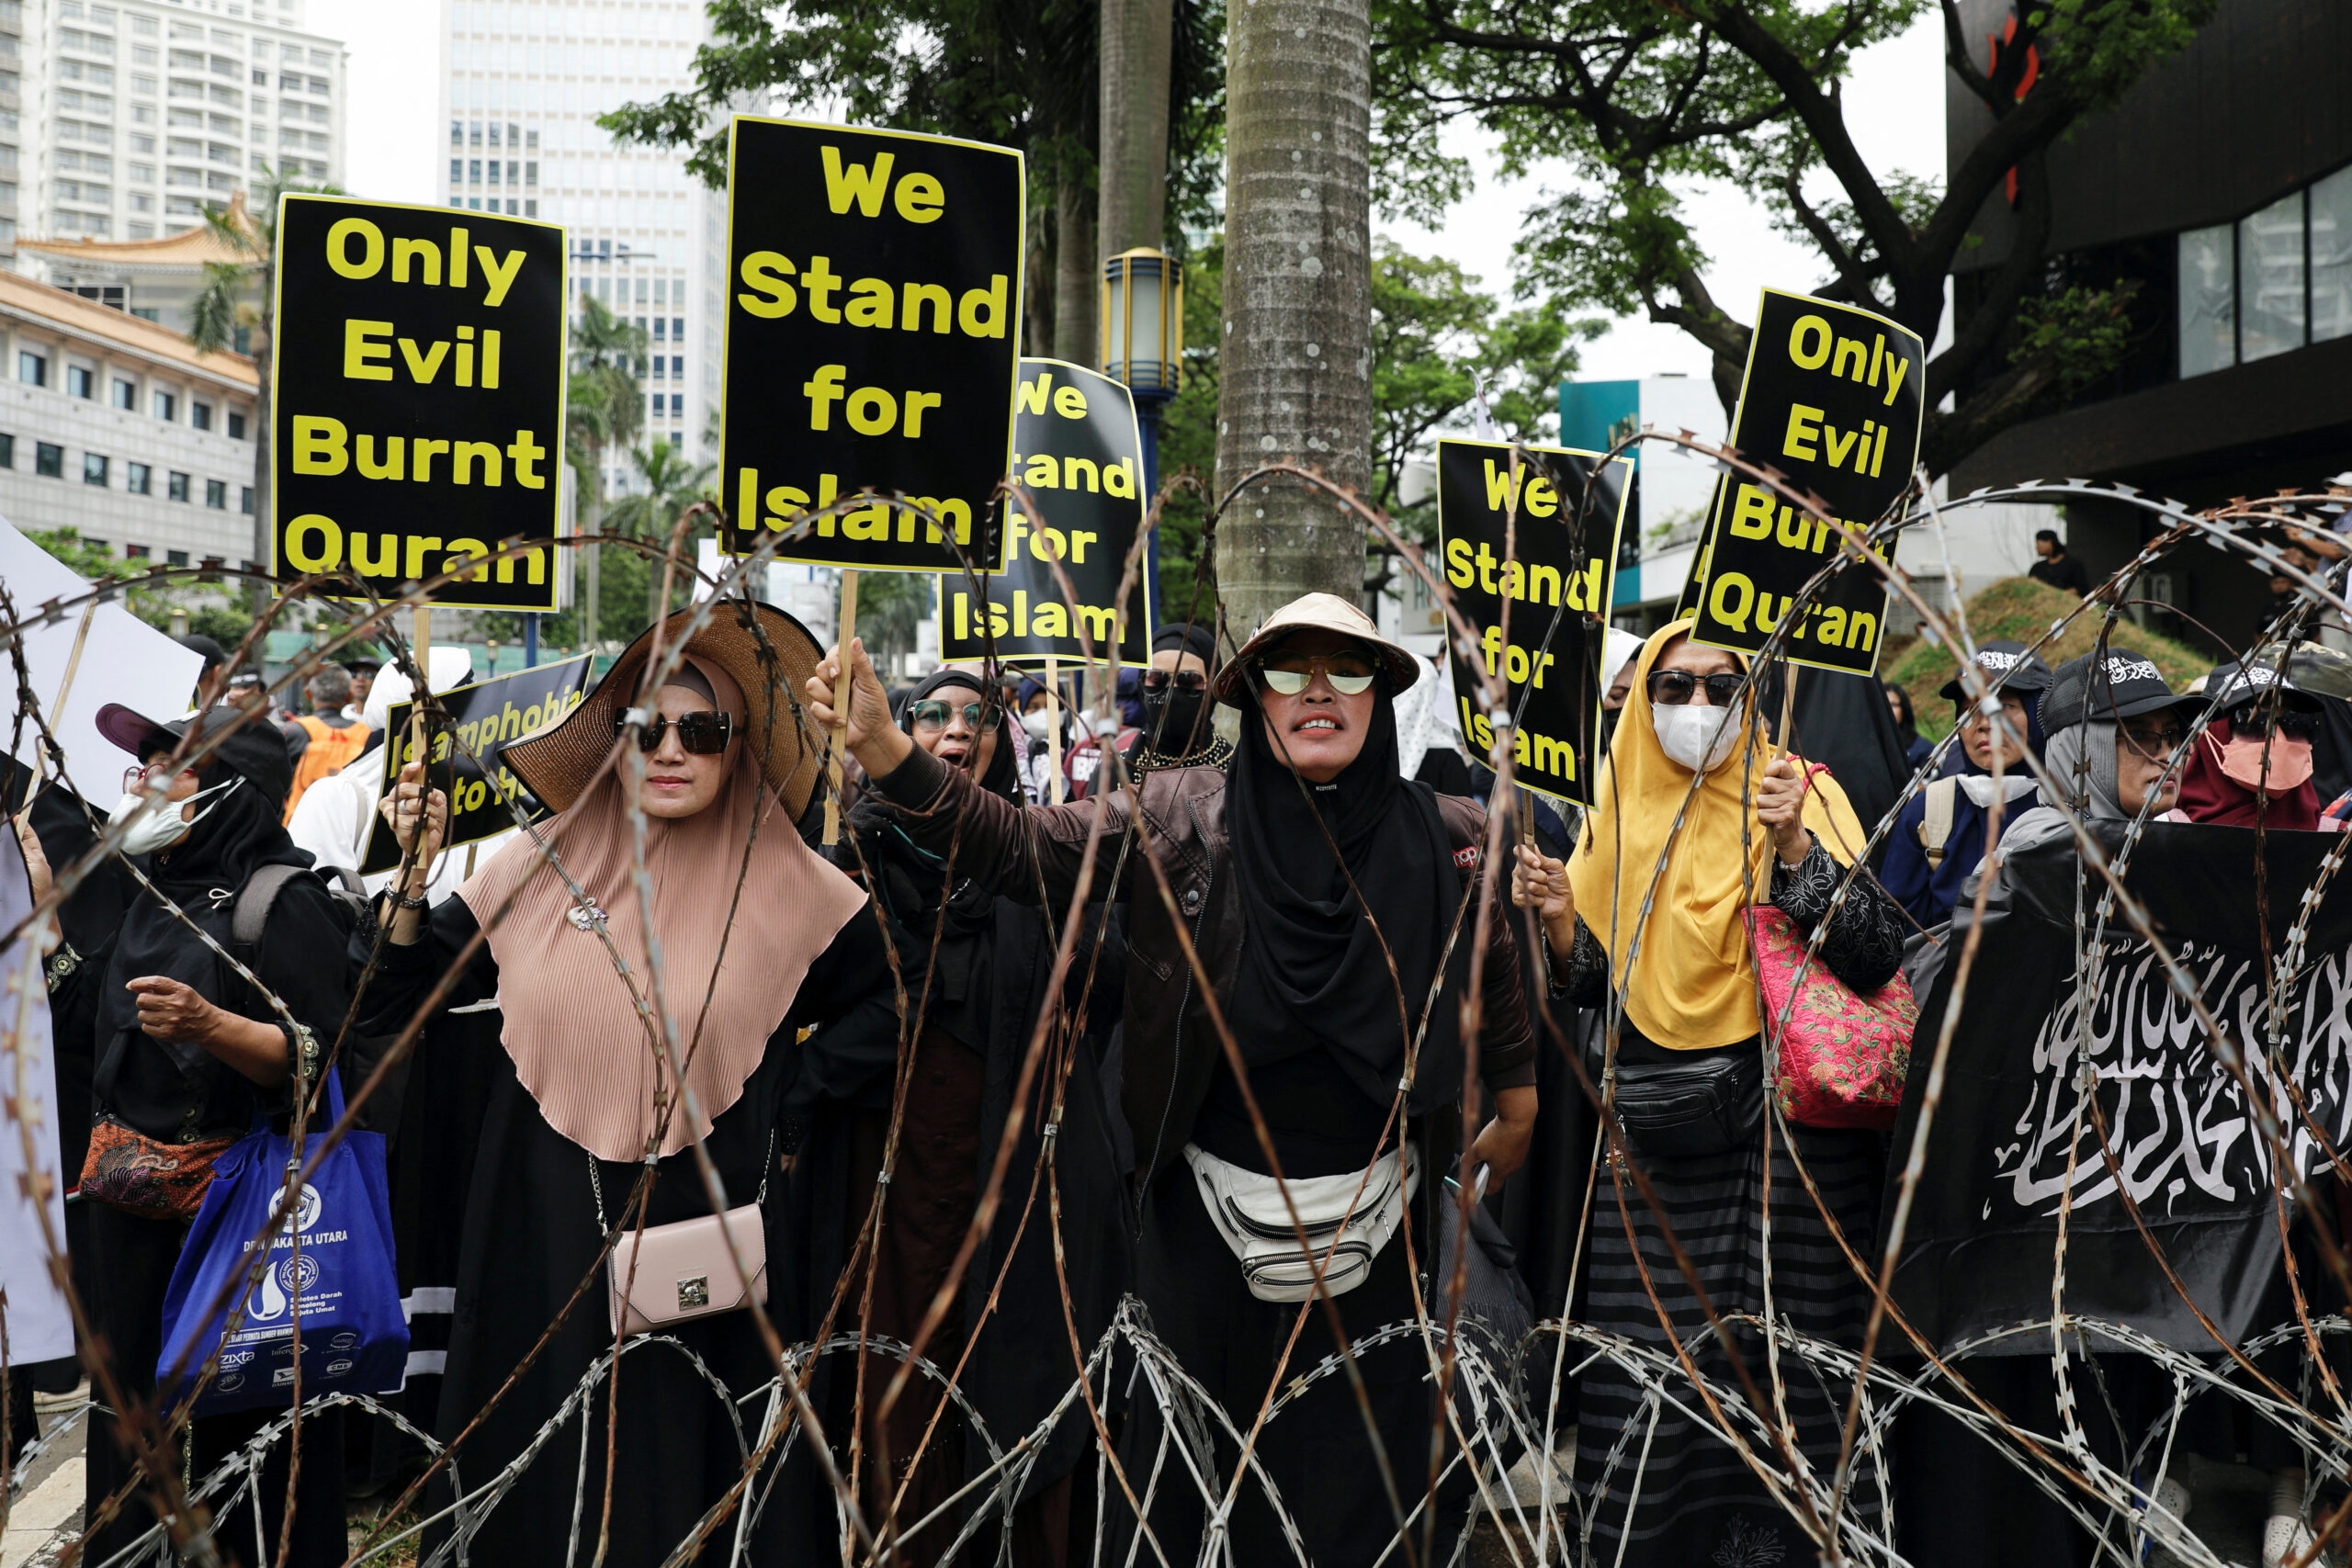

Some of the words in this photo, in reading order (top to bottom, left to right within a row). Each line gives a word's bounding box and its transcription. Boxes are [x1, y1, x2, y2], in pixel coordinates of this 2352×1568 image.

[821, 146, 944, 223] We
[327, 218, 526, 306] Only
[739, 251, 1008, 338] Stand
[345, 320, 500, 389] Evil
[1789, 315, 1908, 405] Only
[804, 365, 941, 437] for
[1017, 373, 1087, 419] We
[293, 415, 545, 489] Burnt
[1013, 453, 1136, 500] and
[1783, 404, 1888, 477] Evil
[739, 468, 972, 545] Islam
[1484, 459, 1558, 518] We
[286, 514, 545, 585] Quran
[1009, 513, 1097, 563] for
[1447, 537, 1603, 613] Stand
[954, 590, 1125, 645] Islam
[1710, 572, 1875, 651] Quran
[1481, 626, 1555, 689] for
[390, 685, 582, 779] Isamphobia
[1461, 696, 1576, 781] Isam
[454, 777, 486, 816] to
[269, 1234, 313, 1250] AKATA
[316, 1230, 347, 1245] UTARA
[321, 1292, 343, 1300] Darah
